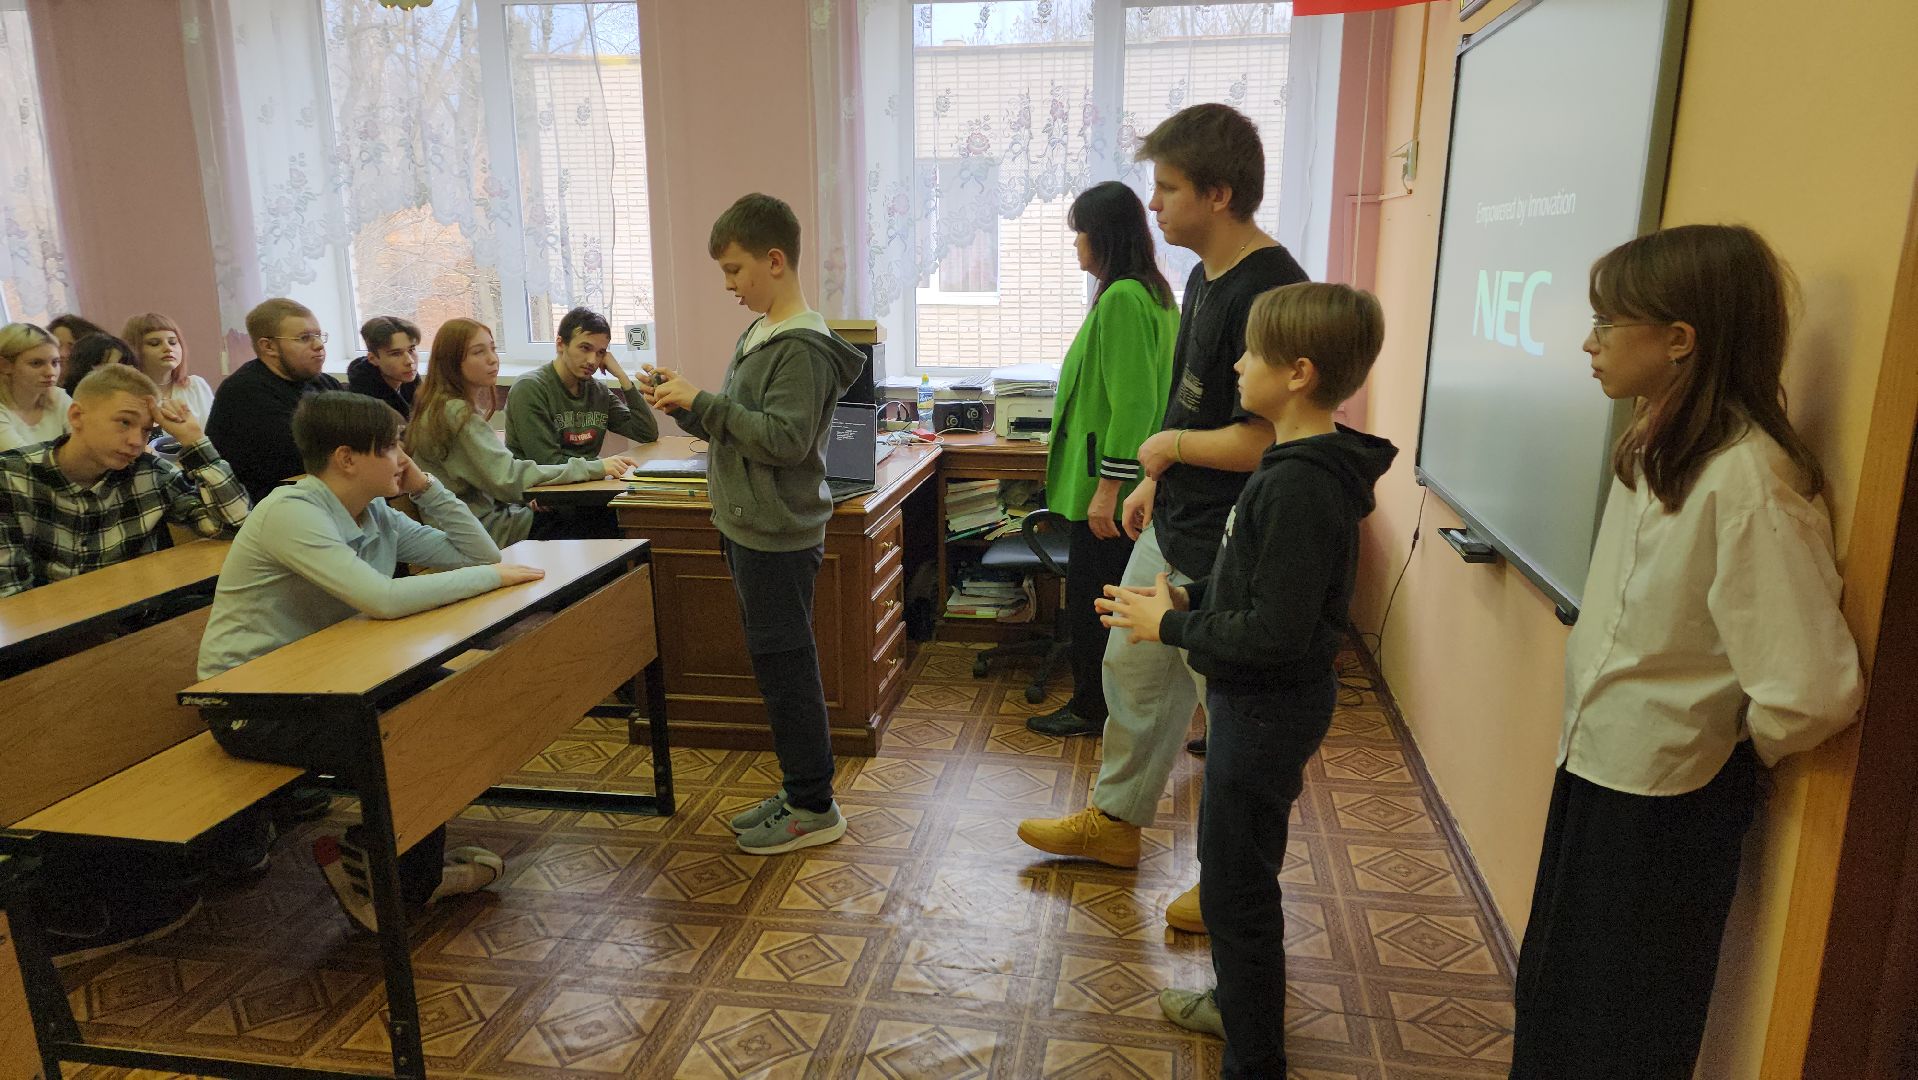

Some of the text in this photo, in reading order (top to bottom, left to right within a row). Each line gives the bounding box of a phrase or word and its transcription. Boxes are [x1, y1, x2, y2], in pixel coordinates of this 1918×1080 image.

[1476, 188, 1576, 229] Empowered by Innovation
[1473, 269, 1552, 356] NEC
